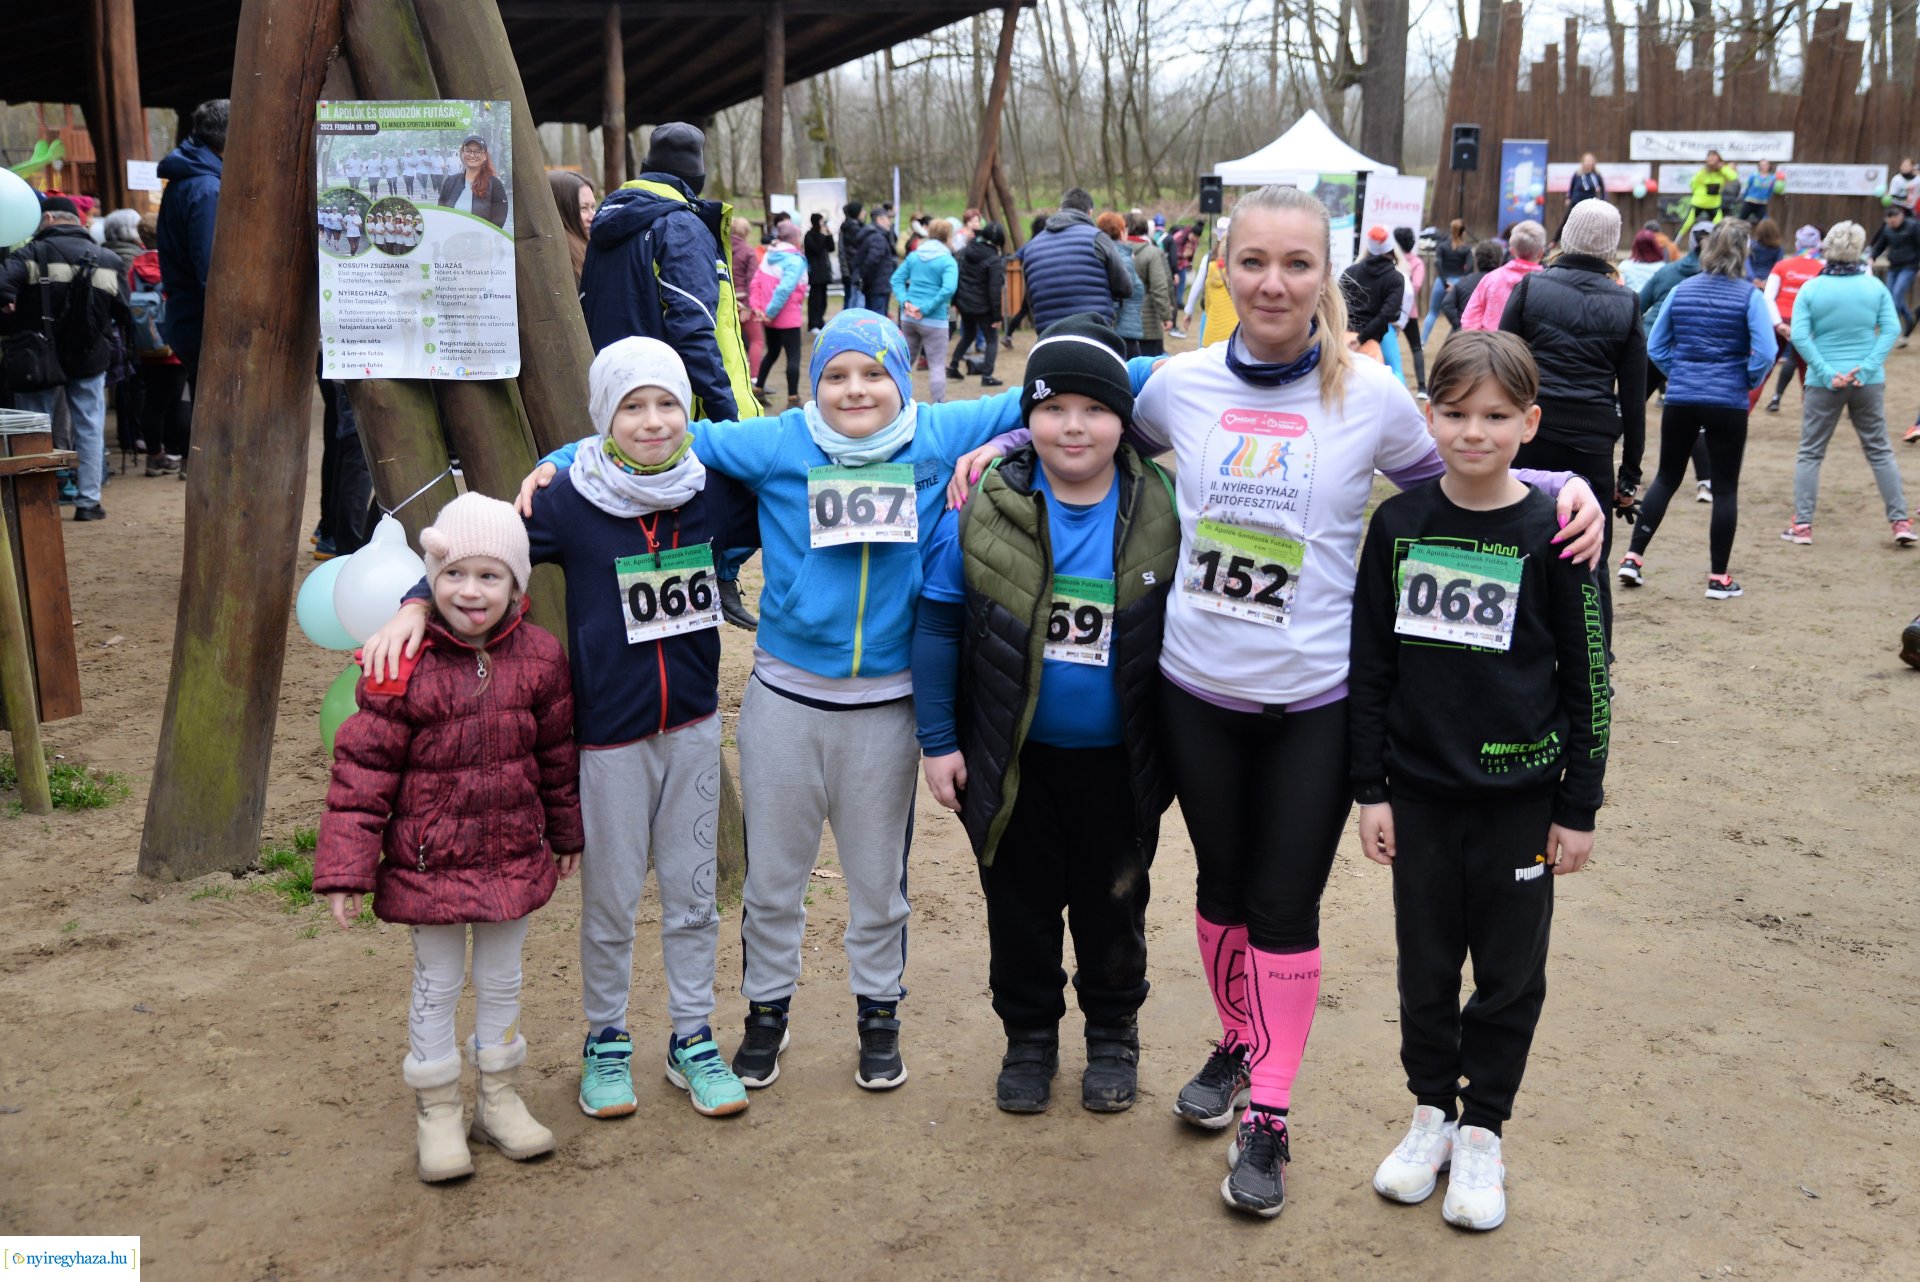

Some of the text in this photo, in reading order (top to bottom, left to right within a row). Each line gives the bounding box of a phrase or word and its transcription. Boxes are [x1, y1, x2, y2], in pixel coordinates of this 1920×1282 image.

[334, 105, 365, 118] ÁPOLÓK
[367, 105, 376, 118] ÉS
[378, 105, 421, 118] GONDOZÓK
[424, 105, 455, 118] FUTÁSA
[334, 122, 355, 130] FEBRUÁR
[382, 120, 388, 128] ÉS
[432, 120, 456, 128] VÁGYÓNAK
[1680, 140, 1724, 150] Fitness
[1372, 195, 1420, 212] Heaven
[916, 474, 939, 491] STYLE
[1210, 481, 1299, 498] II. NYÍREGYHÁZI
[816, 487, 906, 527] 067
[1209, 494, 1297, 512] FUTÓFESZTIVÁL
[1270, 539, 1291, 548] Futása
[1426, 549, 1483, 562] Ápolók-Gondozók
[1197, 550, 1288, 608] 152
[628, 570, 712, 622] 066
[1408, 573, 1506, 626] 068
[1582, 584, 1610, 758] MINECRAFT
[1480, 732, 1559, 755] MINECRAFT
[1269, 969, 1319, 980] RUNTO
